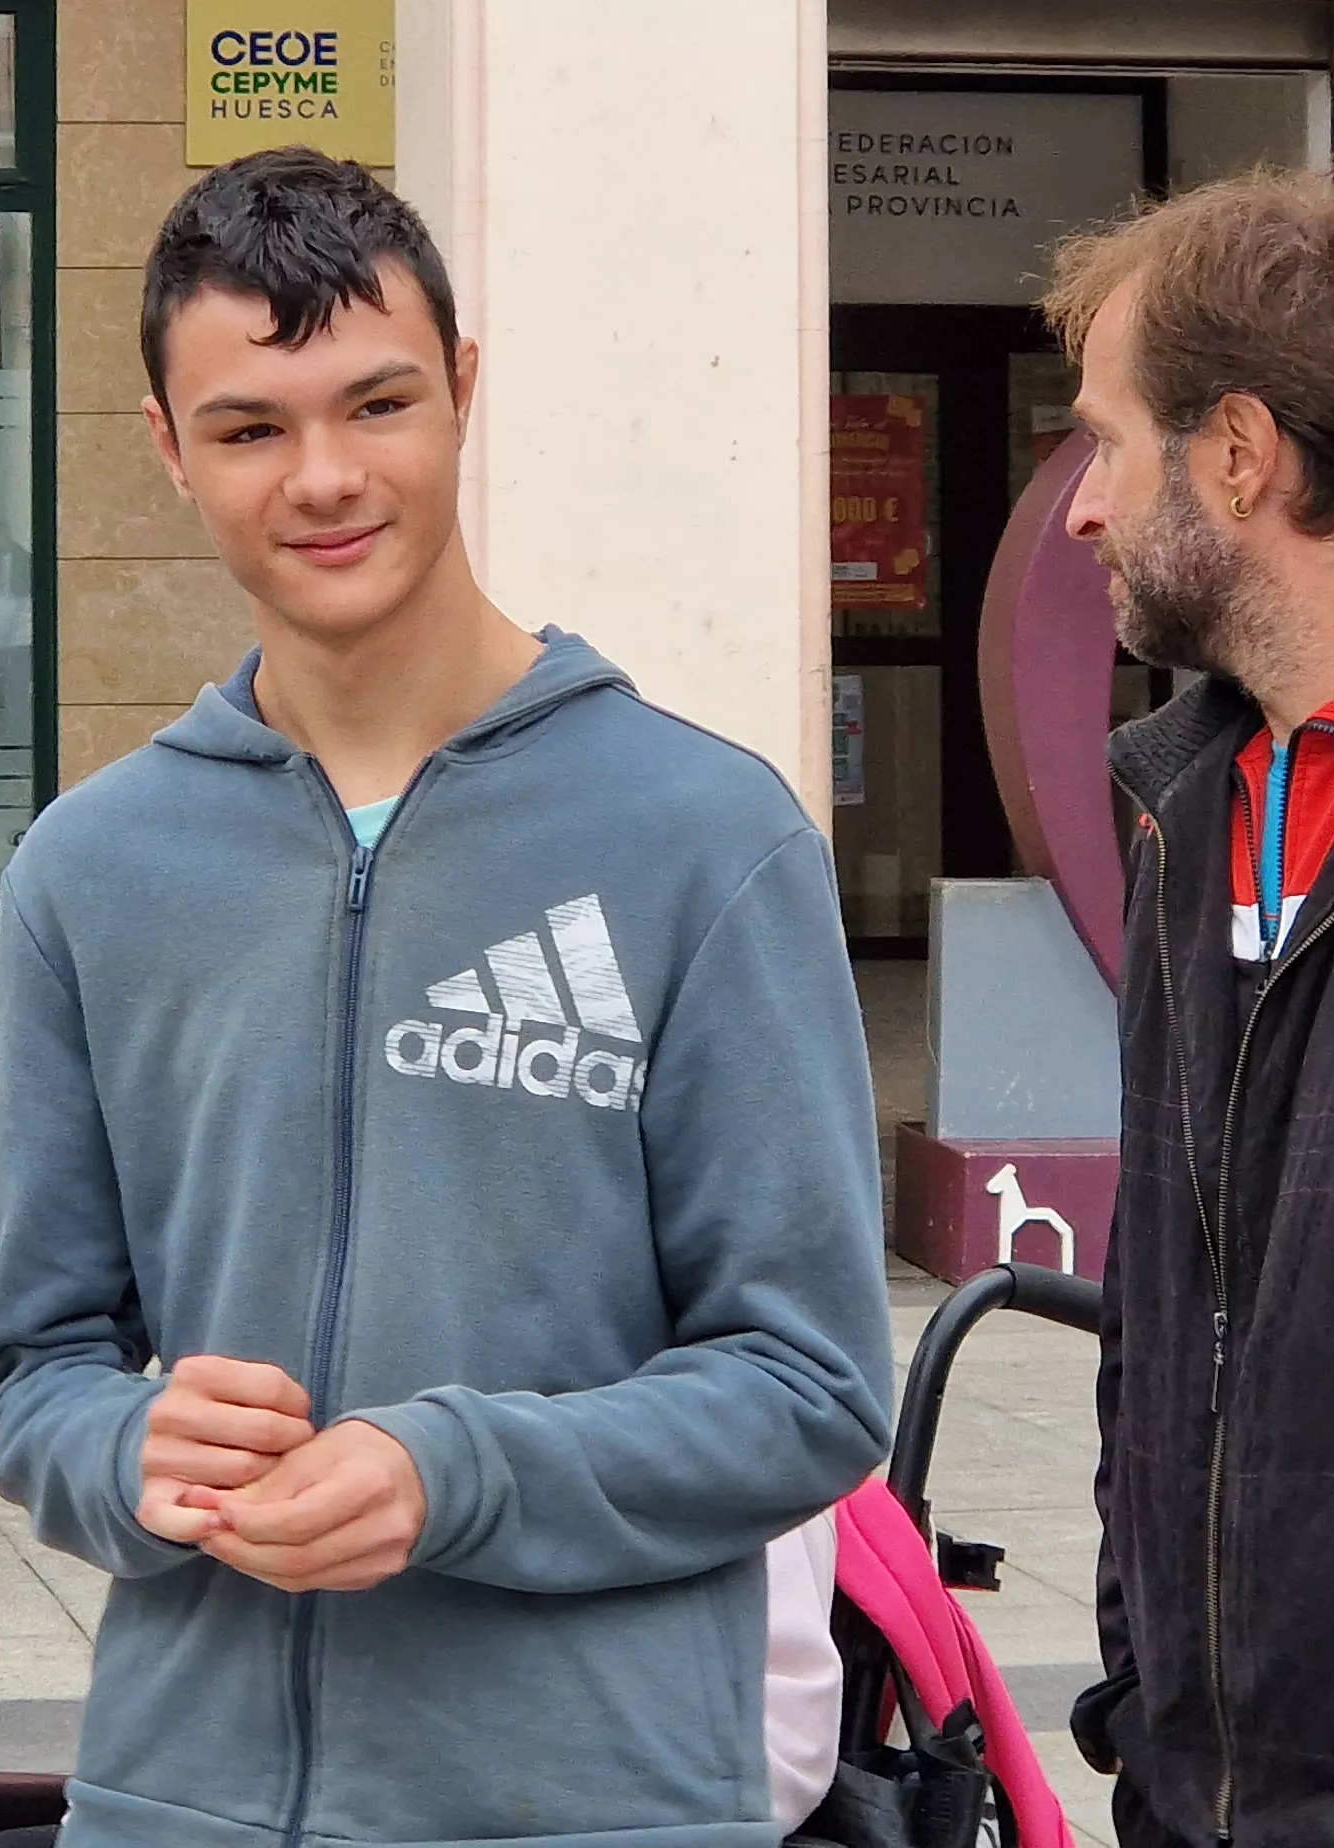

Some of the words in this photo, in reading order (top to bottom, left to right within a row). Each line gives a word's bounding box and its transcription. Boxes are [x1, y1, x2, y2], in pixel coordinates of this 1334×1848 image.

[211, 30, 338, 66] CEOE
[211, 72, 338, 94] CEPYME
[211, 99, 339, 119] HUESCA
[848, 195, 1021, 217] PROVINCIA
